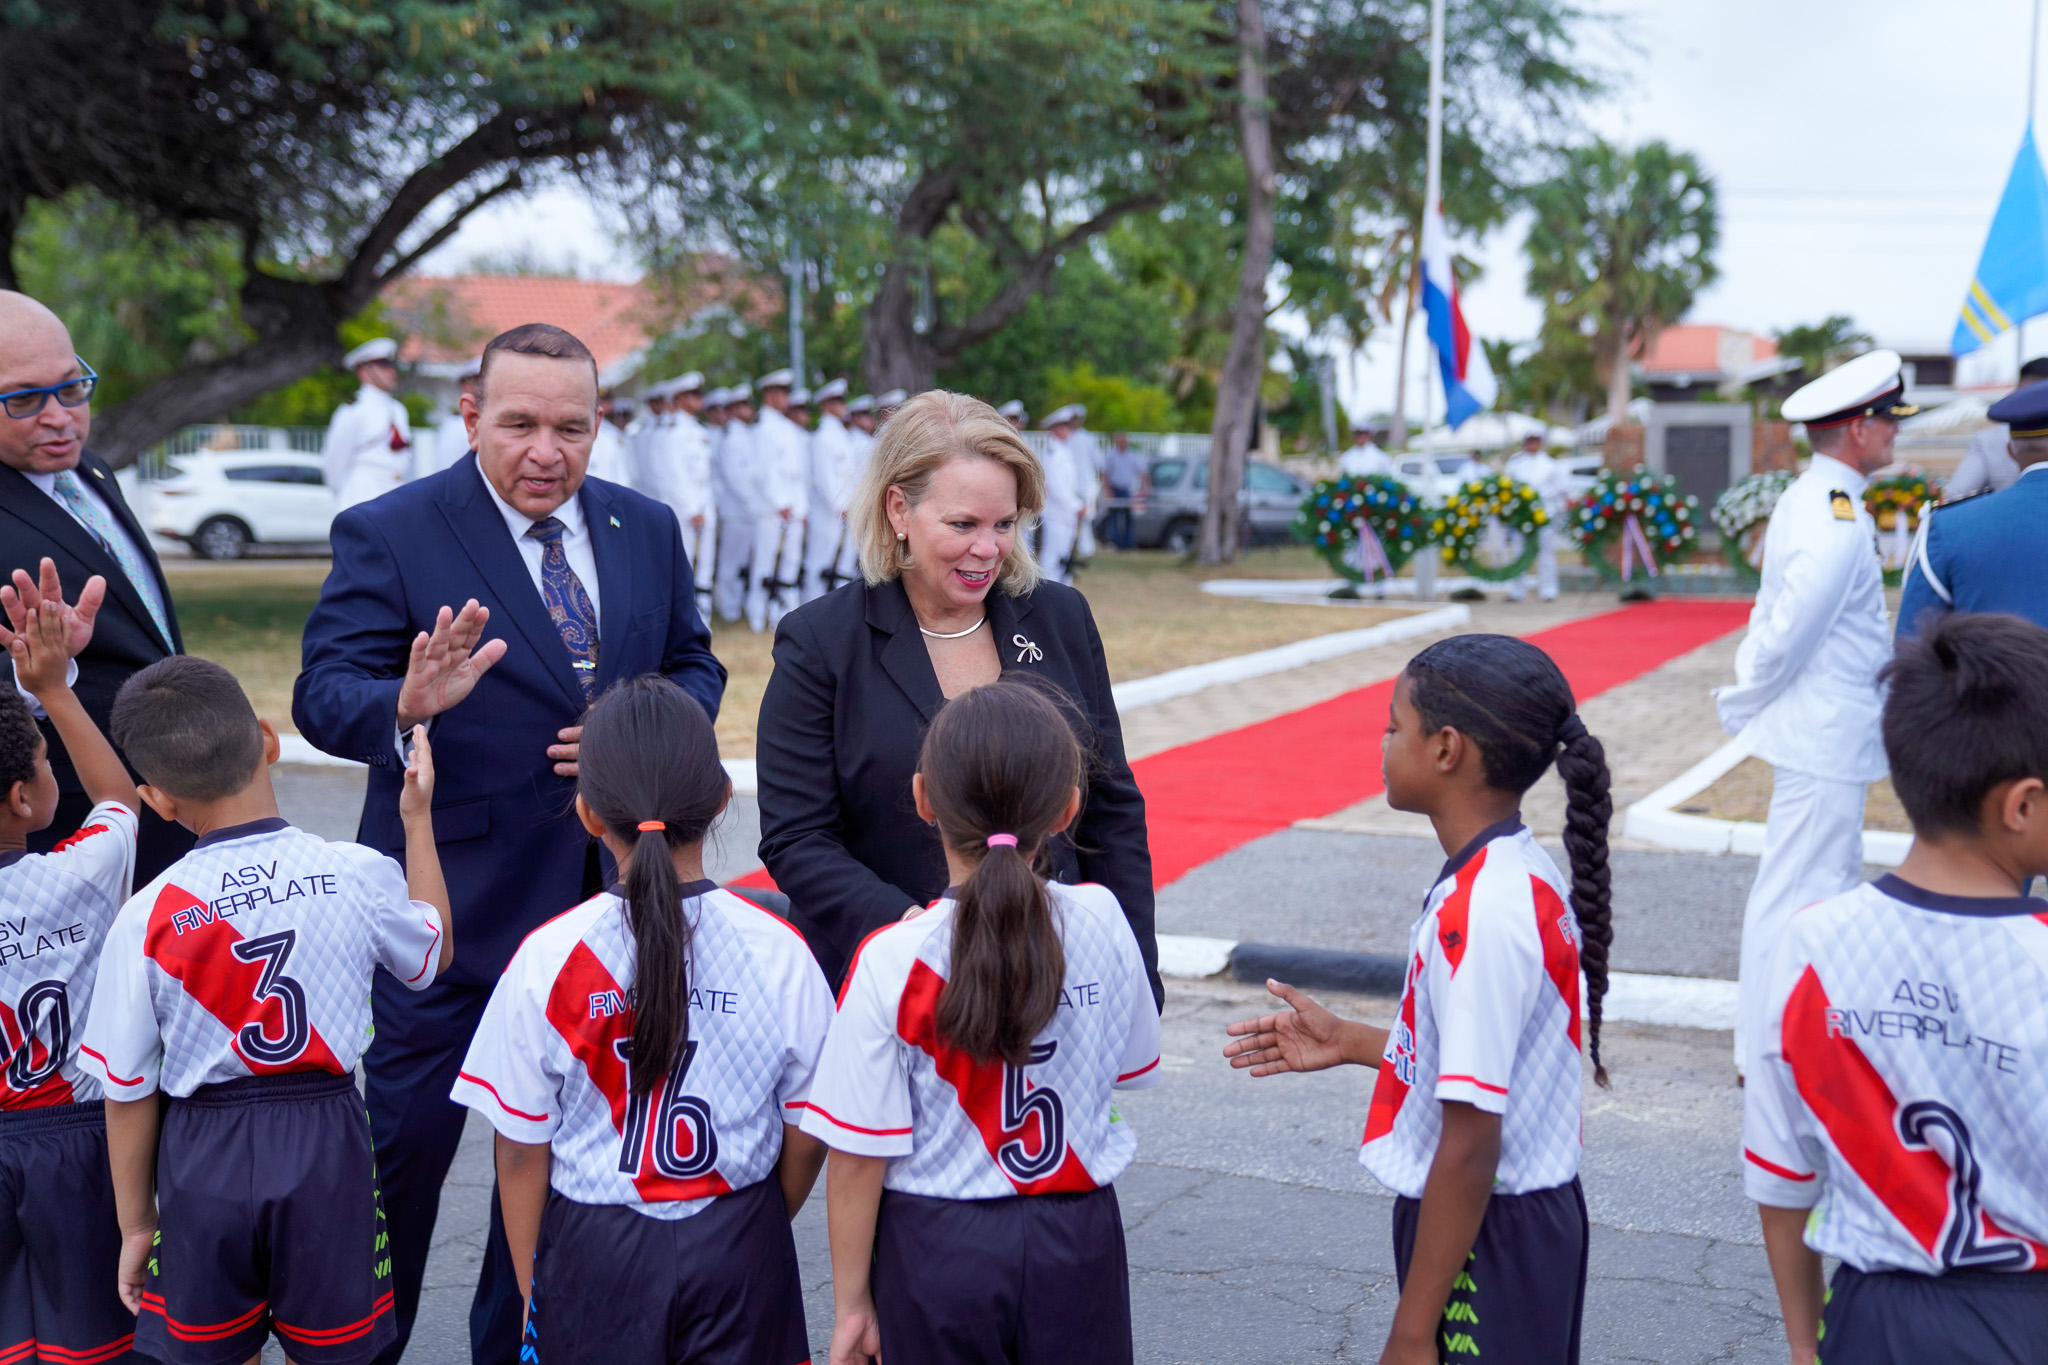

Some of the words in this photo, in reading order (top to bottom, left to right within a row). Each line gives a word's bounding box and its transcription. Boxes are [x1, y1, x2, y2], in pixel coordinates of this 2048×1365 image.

[172, 874, 338, 935] RIVERPLATE
[221, 860, 277, 892] ASV
[231, 928, 309, 1065] 3
[614, 1037, 718, 1179] 16
[999, 1039, 1066, 1183] 5
[1897, 1098, 2034, 1272] 2
